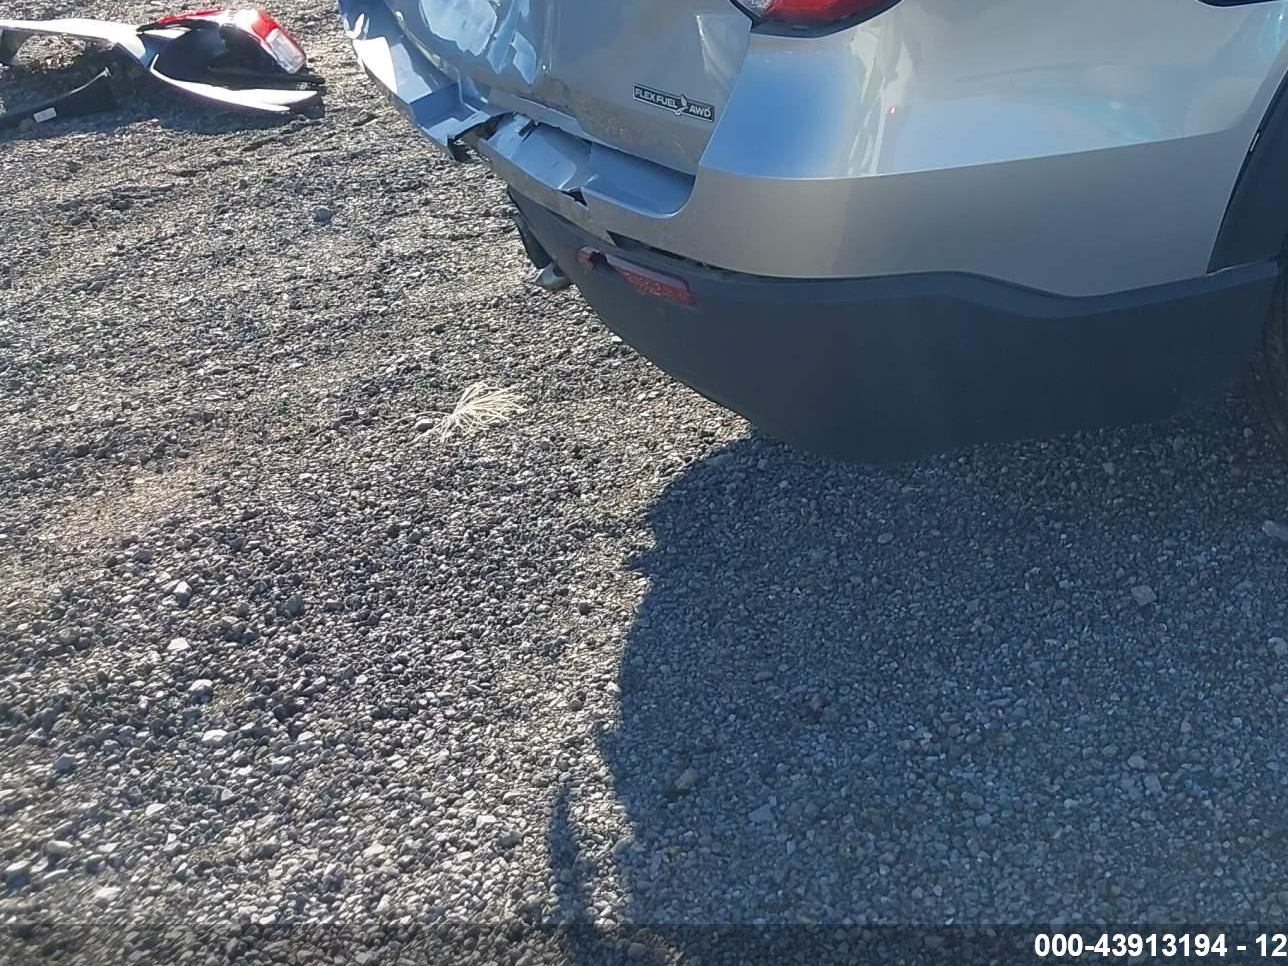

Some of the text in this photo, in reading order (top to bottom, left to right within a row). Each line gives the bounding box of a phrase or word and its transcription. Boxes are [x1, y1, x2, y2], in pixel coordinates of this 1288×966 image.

[635, 88, 711, 118] FLEX FUEL AWD
